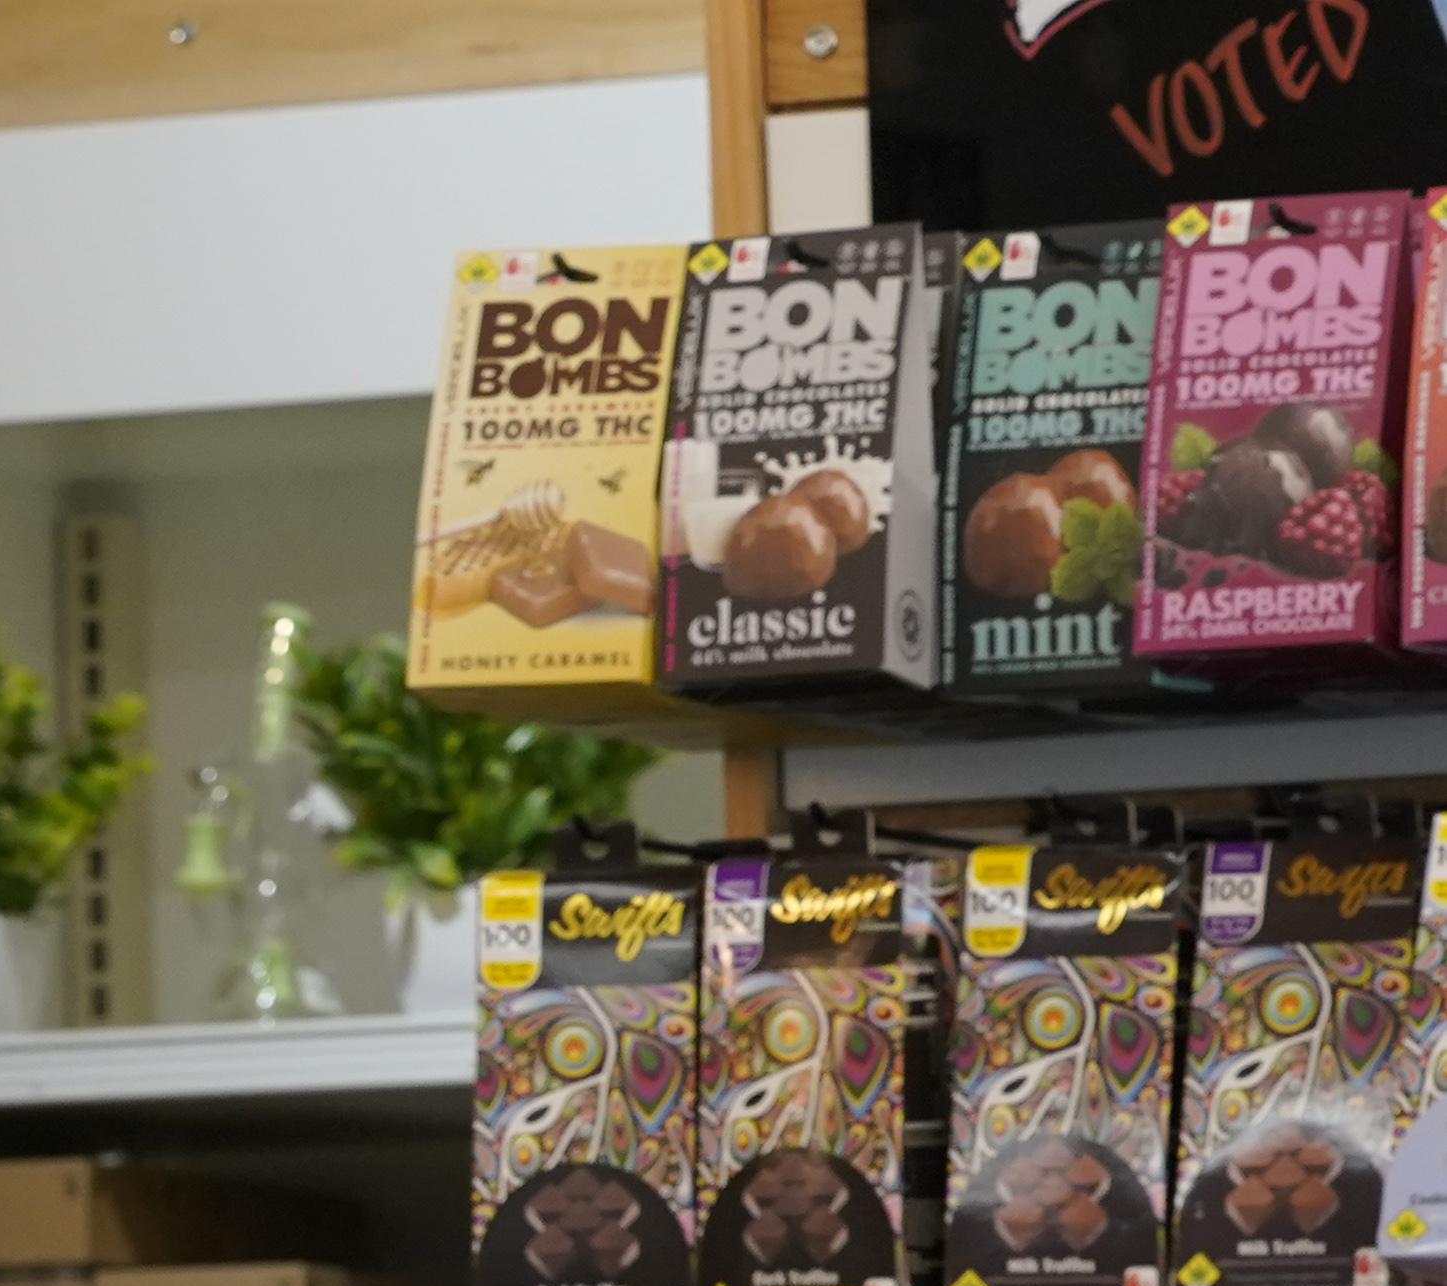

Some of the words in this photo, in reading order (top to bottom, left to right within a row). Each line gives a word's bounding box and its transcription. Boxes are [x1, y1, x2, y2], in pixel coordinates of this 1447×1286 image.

[1110, 0, 1368, 177] VOTED
[1187, 242, 1388, 317] BON
[477, 296, 672, 359] BON
[708, 279, 903, 351] BON
[979, 277, 1161, 352] BON
[1181, 304, 1382, 357] BOMBS
[470, 354, 661, 399] BOMBS
[699, 341, 896, 393] BOMBS
[973, 344, 1151, 395] BOMBS
[1175, 369, 1301, 401] 100MG
[1312, 366, 1374, 392] THC
[462, 420, 580, 441] 100MG
[595, 415, 654, 438] THC
[693, 406, 815, 437] 100MG
[822, 401, 888, 429] THC
[968, 411, 1082, 441] 100MG
[688, 588, 856, 648] classic
[973, 591, 1122, 660] mint
[1161, 580, 1364, 623] RASPBERRY
[441, 653, 519, 671] HONEY
[531, 650, 632, 669] CARAMEL
